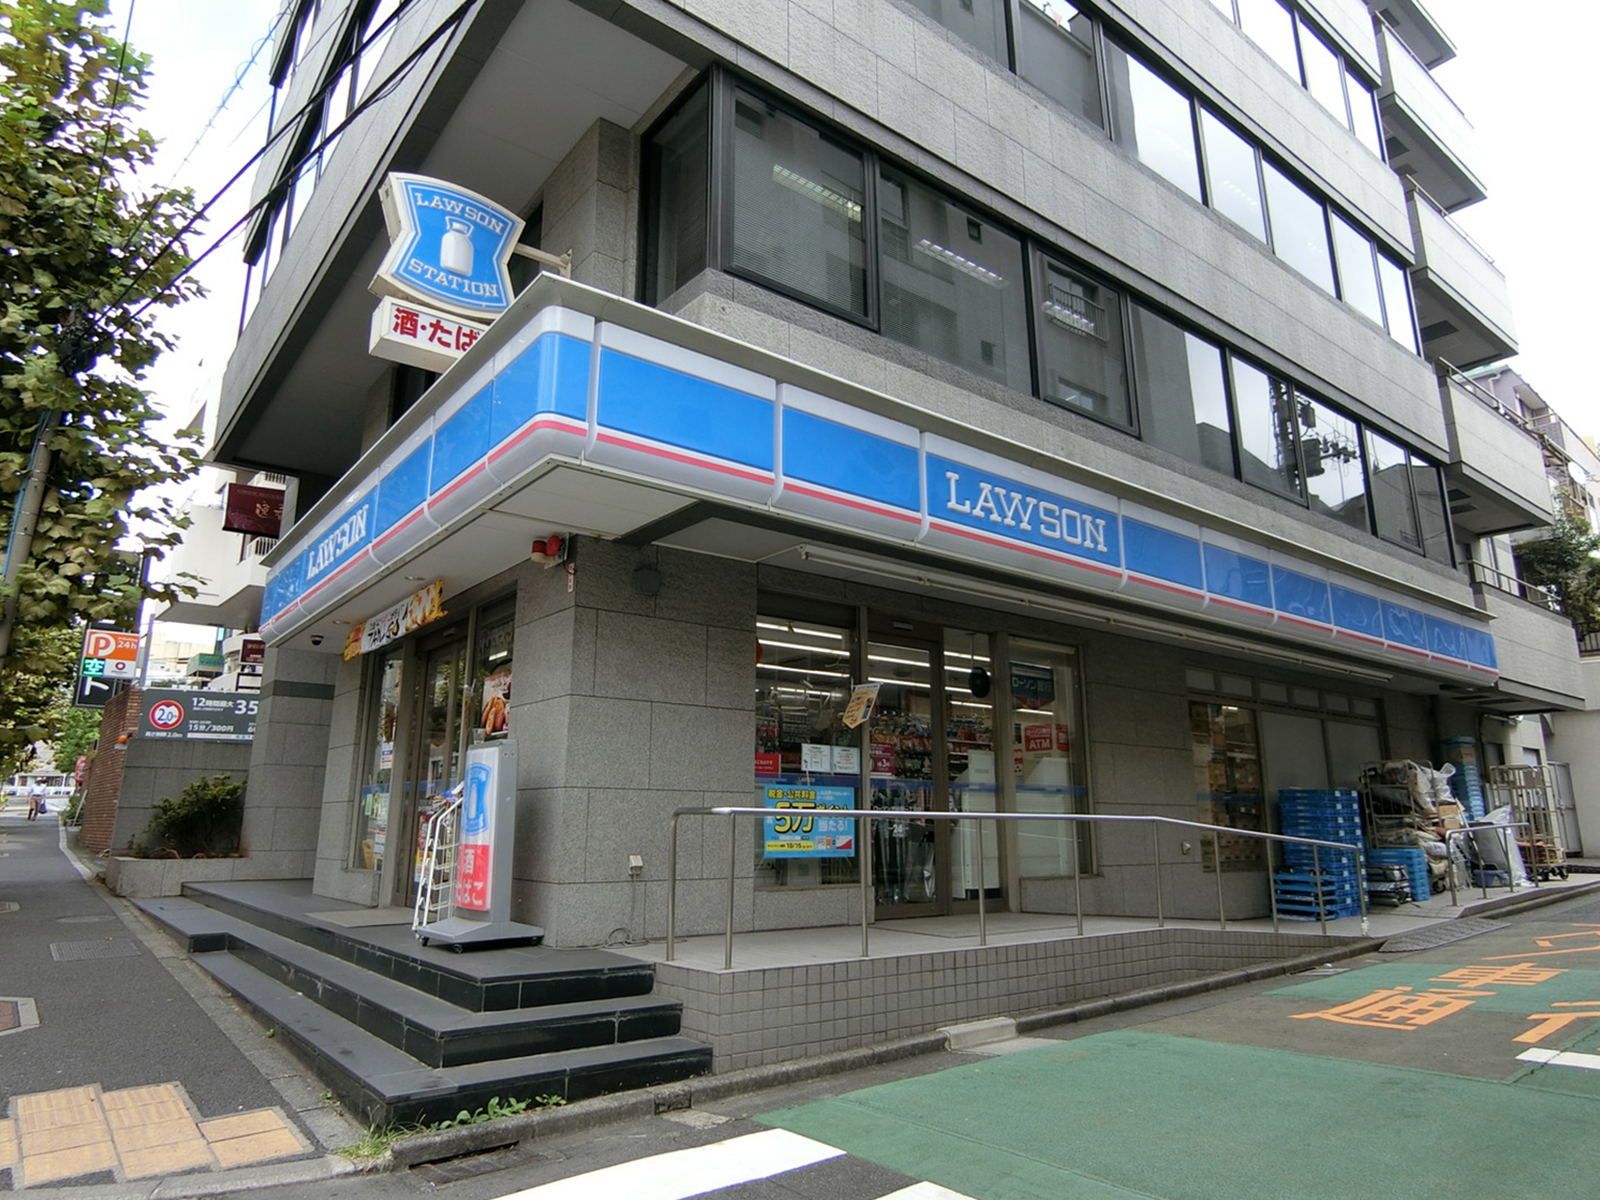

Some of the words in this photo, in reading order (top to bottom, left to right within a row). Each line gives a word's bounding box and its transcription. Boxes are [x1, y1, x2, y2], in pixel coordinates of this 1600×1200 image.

[414, 192, 505, 235] LAWSON
[408, 258, 500, 298] STATION
[945, 471, 1108, 553] LAWSON
[306, 504, 370, 582] LAWSON
[88, 633, 116, 657] P
[117, 640, 138, 650] 24h
[82, 658, 106, 675] 空
[1029, 739, 1051, 750] ATM
[774, 801, 816, 833] 5万
